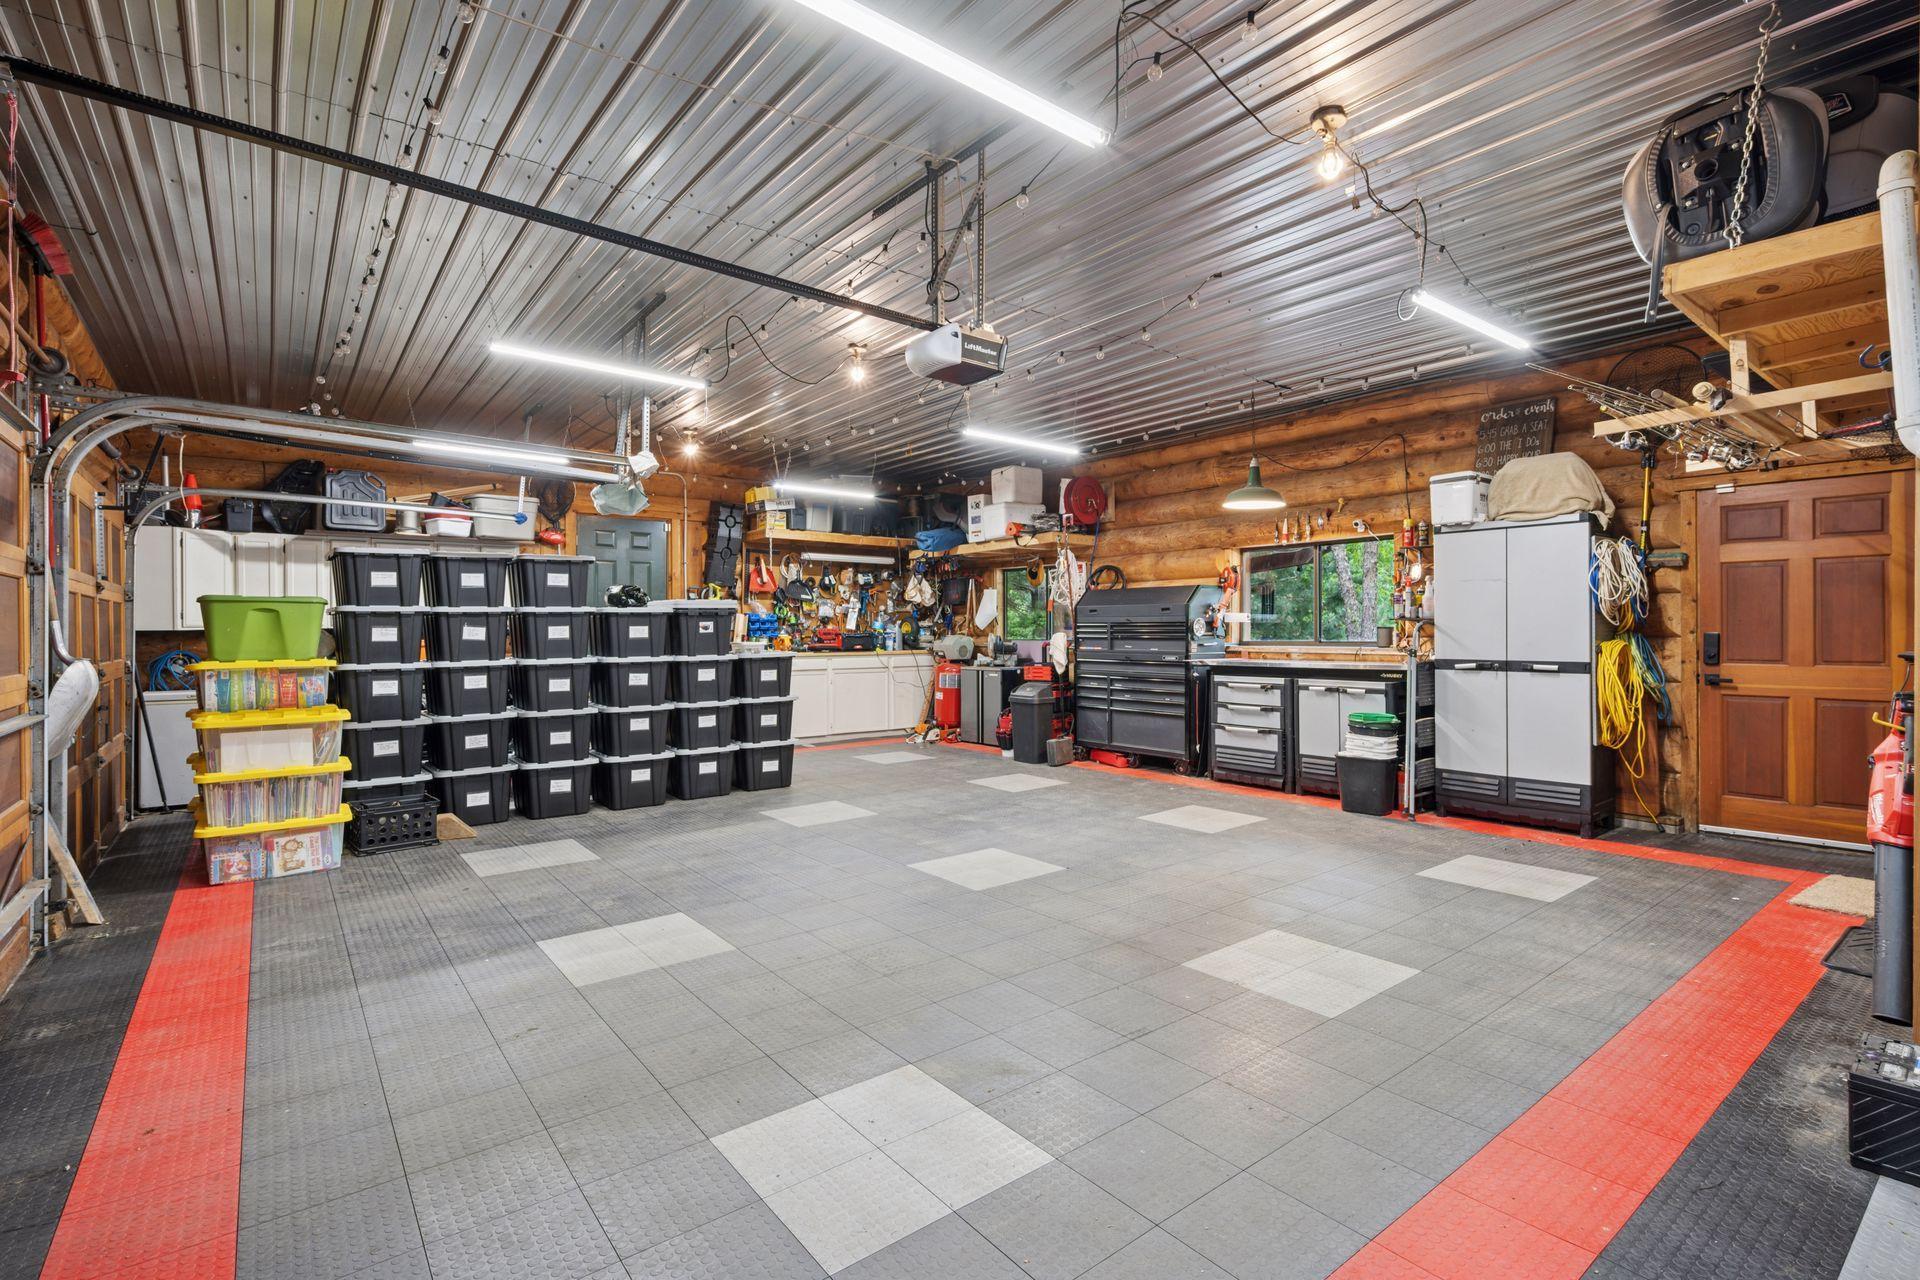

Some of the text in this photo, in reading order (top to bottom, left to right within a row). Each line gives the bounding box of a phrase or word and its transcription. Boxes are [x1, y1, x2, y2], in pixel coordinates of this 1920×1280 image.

[964, 342, 997, 356] LiftMaster
[1530, 419, 1548, 432] SEAT
[1500, 439, 1512, 451] THE
